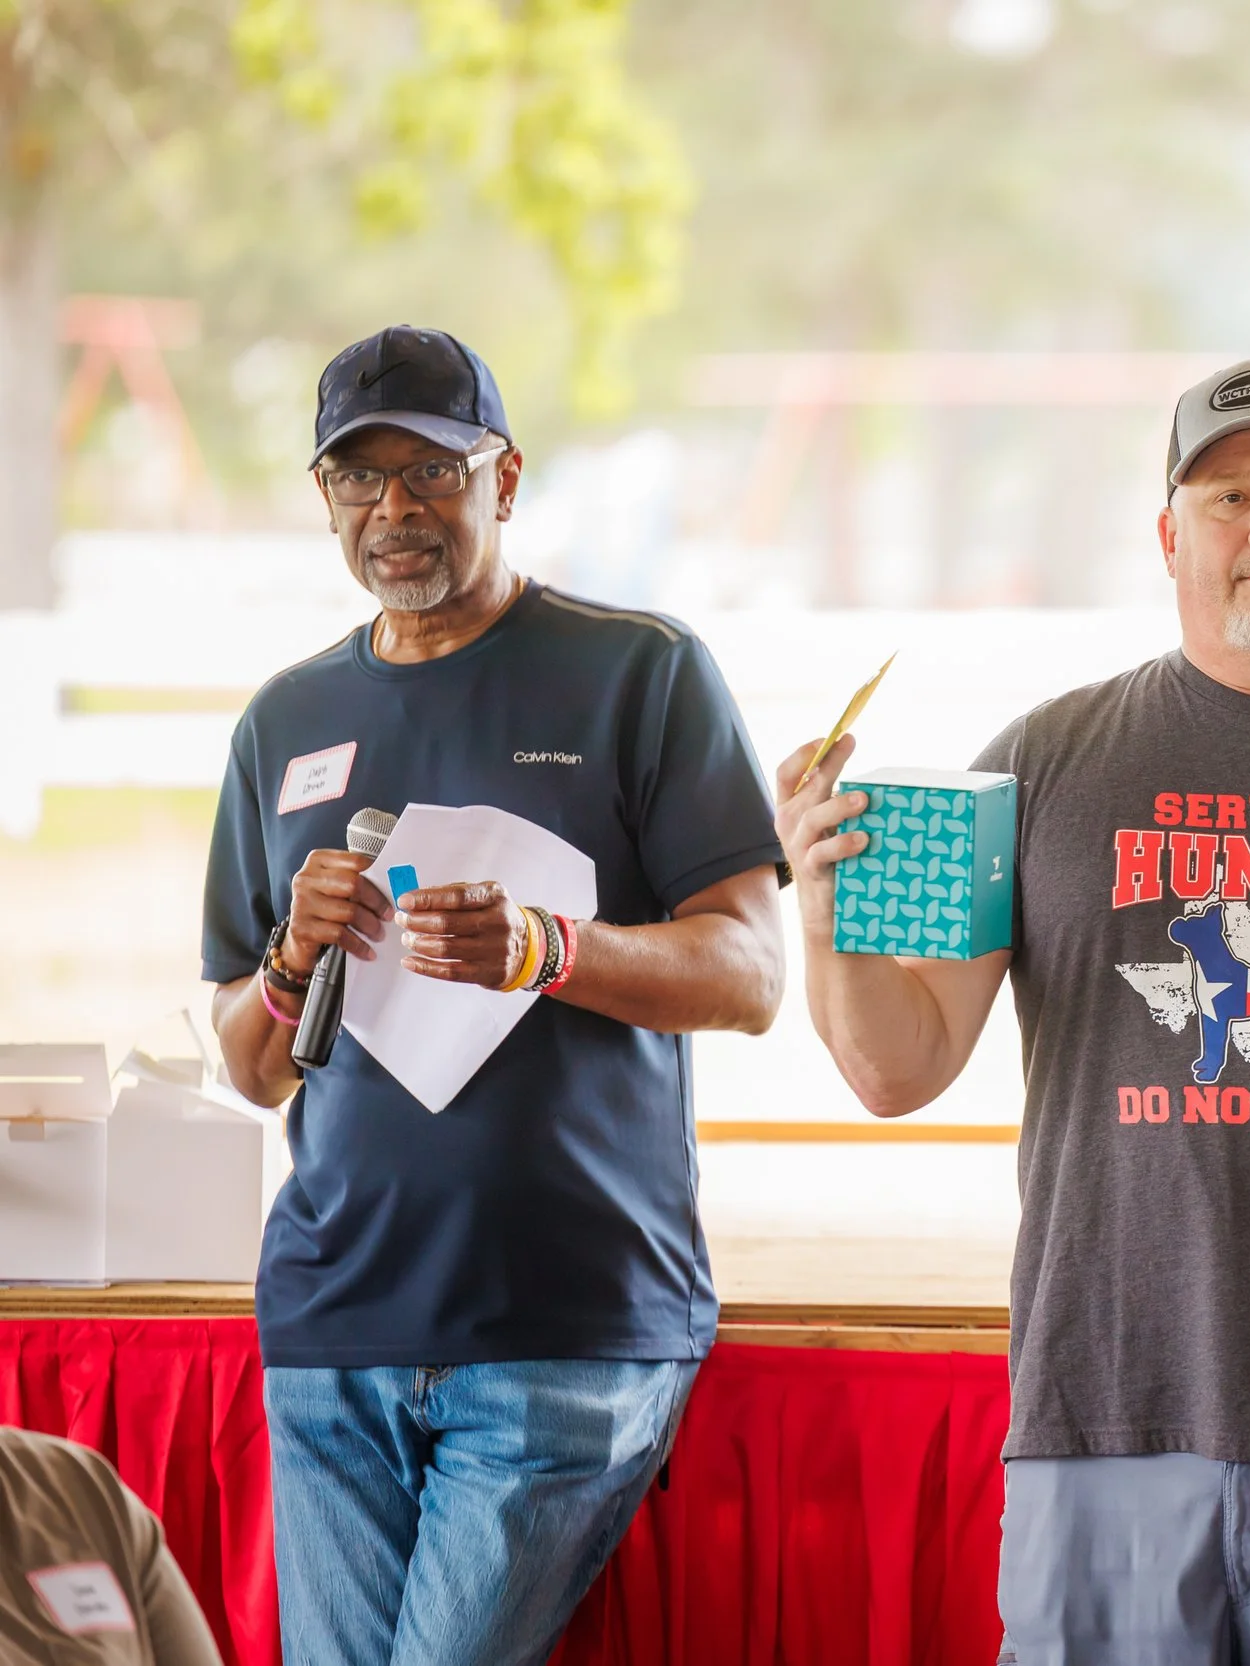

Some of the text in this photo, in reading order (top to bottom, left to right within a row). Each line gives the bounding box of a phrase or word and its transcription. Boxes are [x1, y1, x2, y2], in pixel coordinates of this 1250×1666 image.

[513, 750, 582, 765] Calvin Klein
[1117, 1086, 1171, 1124] DO
